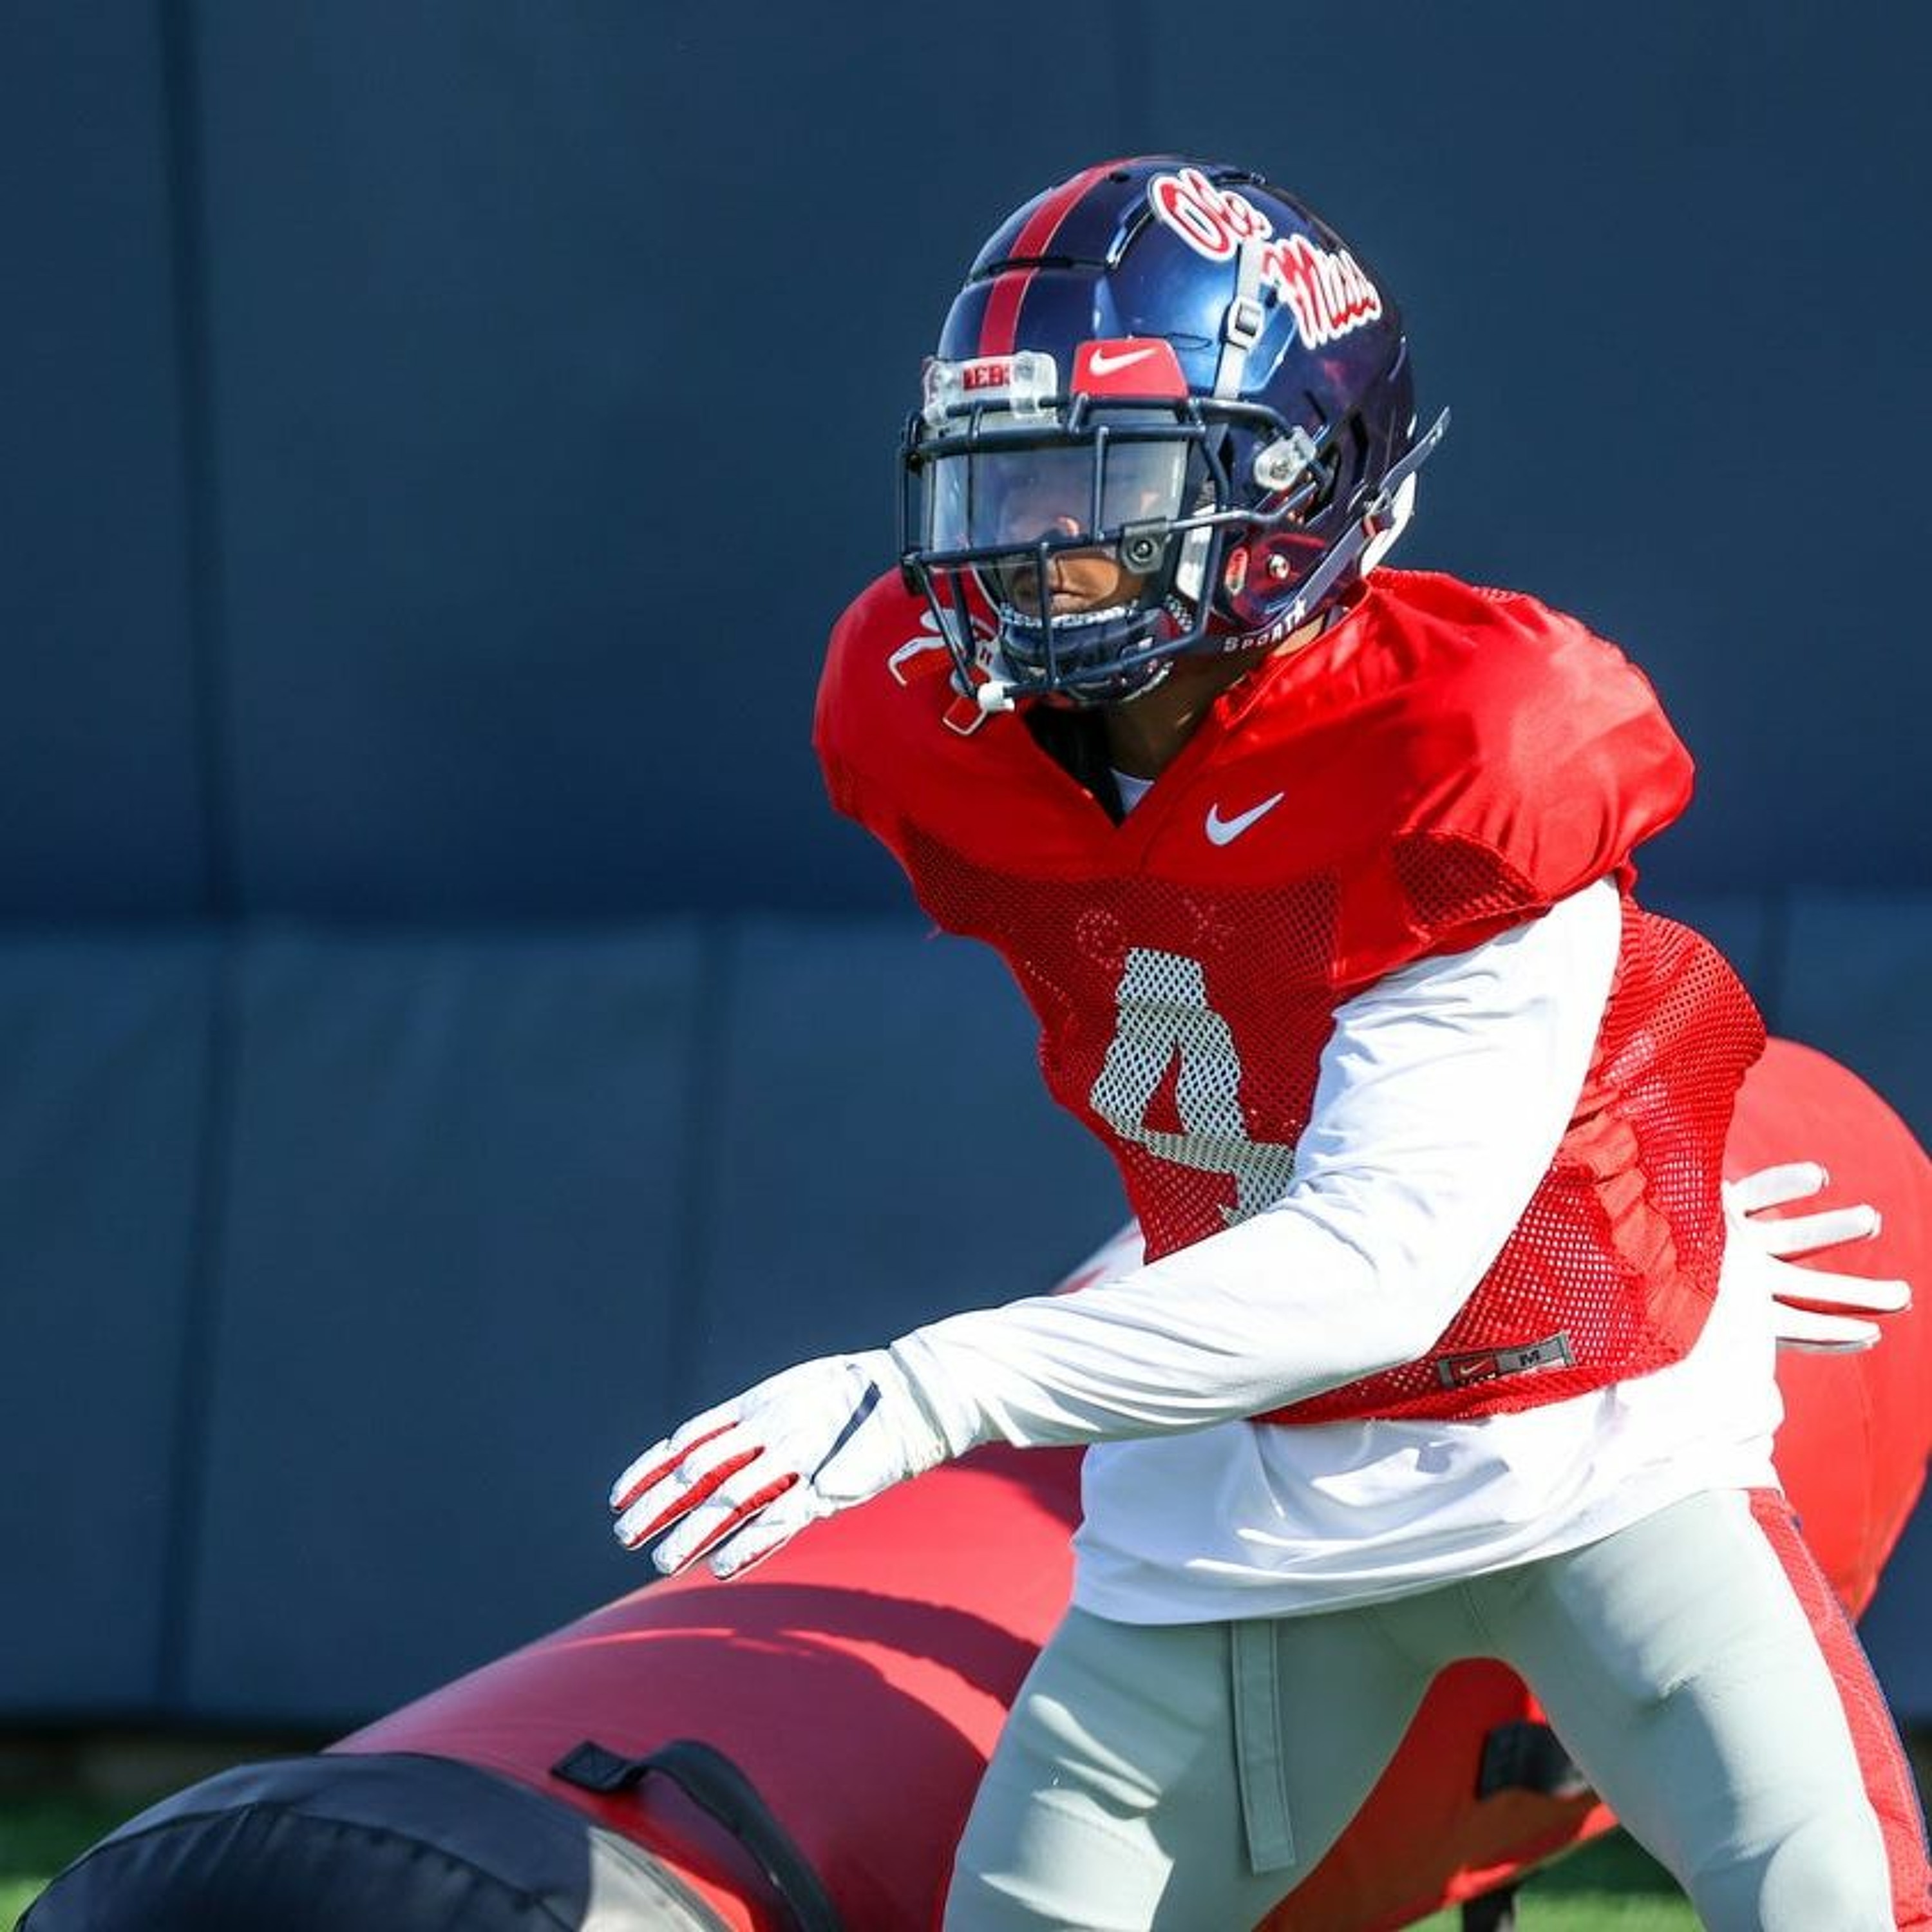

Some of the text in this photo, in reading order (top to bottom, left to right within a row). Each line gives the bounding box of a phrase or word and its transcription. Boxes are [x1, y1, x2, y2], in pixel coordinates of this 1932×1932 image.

[1149, 168, 1383, 350] Ole Miss
[1090, 947, 1294, 1227] 4
[1519, 1350, 1540, 1367] M
